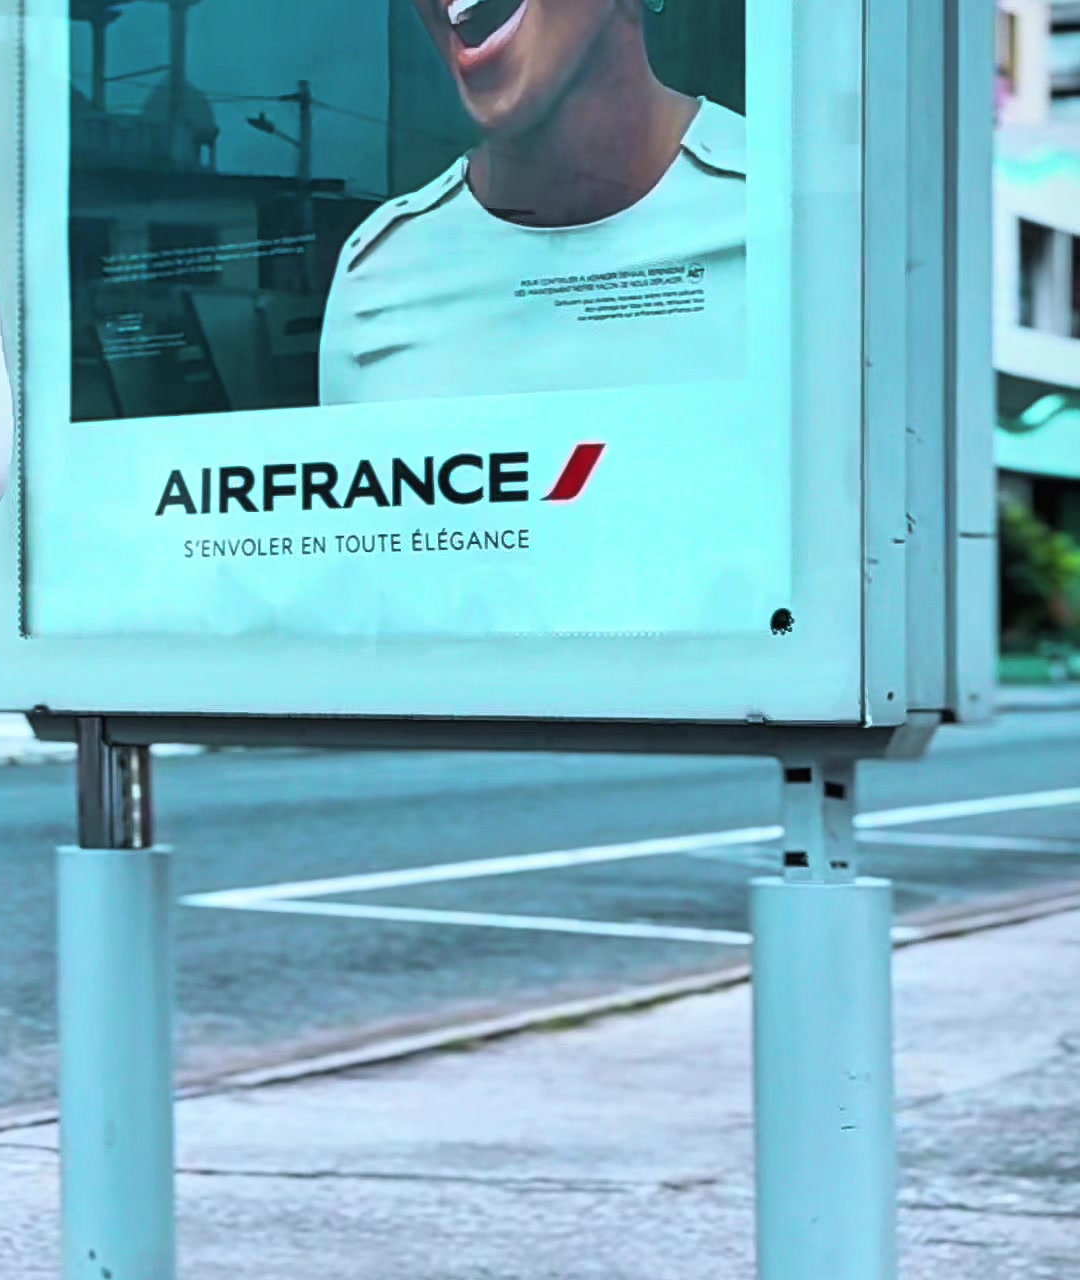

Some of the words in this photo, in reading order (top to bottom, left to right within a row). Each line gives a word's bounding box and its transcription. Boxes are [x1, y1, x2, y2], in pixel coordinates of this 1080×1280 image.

[185, 536, 293, 558] S'ENVOLER
[302, 535, 326, 555] EN
[336, 533, 402, 553] TOUTE
[412, 528, 530, 551] ÉLÉGANCE
